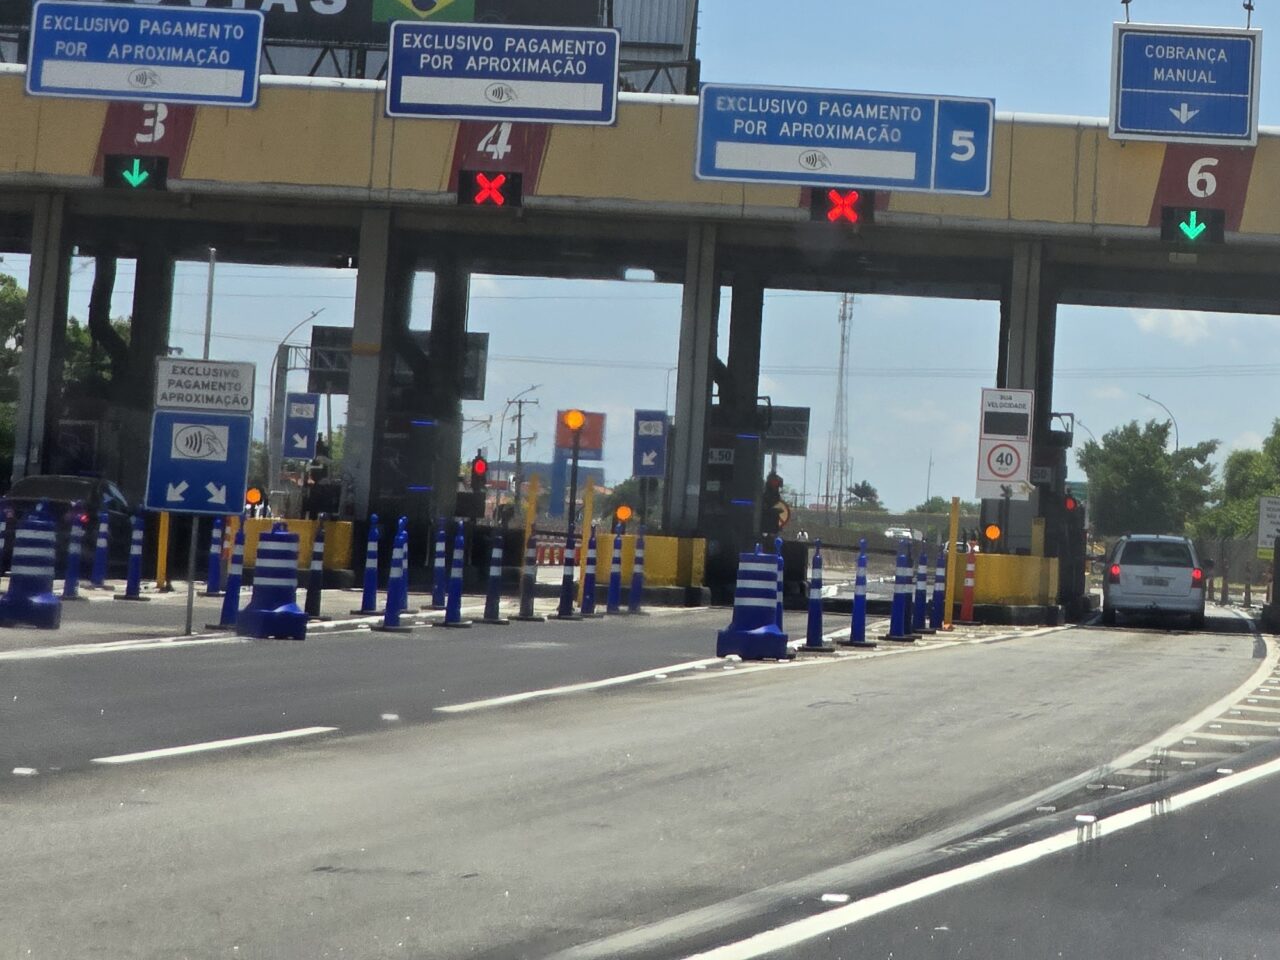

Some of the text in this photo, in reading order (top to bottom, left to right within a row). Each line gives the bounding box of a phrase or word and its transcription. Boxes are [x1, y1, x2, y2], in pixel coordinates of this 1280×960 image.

[42, 15, 244, 40] EXCLUSIVO PAGAMENTO
[55, 40, 230, 66] POR APROXIMAÇÃO
[402, 33, 607, 56] EXCLUSIVO PAGAMENTO
[1145, 44, 1228, 64] COBRANÇA
[419, 54, 587, 77] POR APROXIMAÇÃO
[1153, 67, 1217, 84] MANUAL
[716, 96, 922, 122] EXCLUSIVO PAGAMENTO
[134, 103, 169, 143] 3
[733, 119, 902, 143] POR APROXIMAÇÃO
[476, 121, 513, 160] 4
[950, 129, 976, 162] 5
[1187, 157, 1219, 198] 6
[172, 365, 240, 378] EXCLUSIVO
[168, 379, 242, 392] PAGAMENTO
[160, 392, 249, 407] APROXIMAÇÃO
[996, 452, 1014, 466] 40
